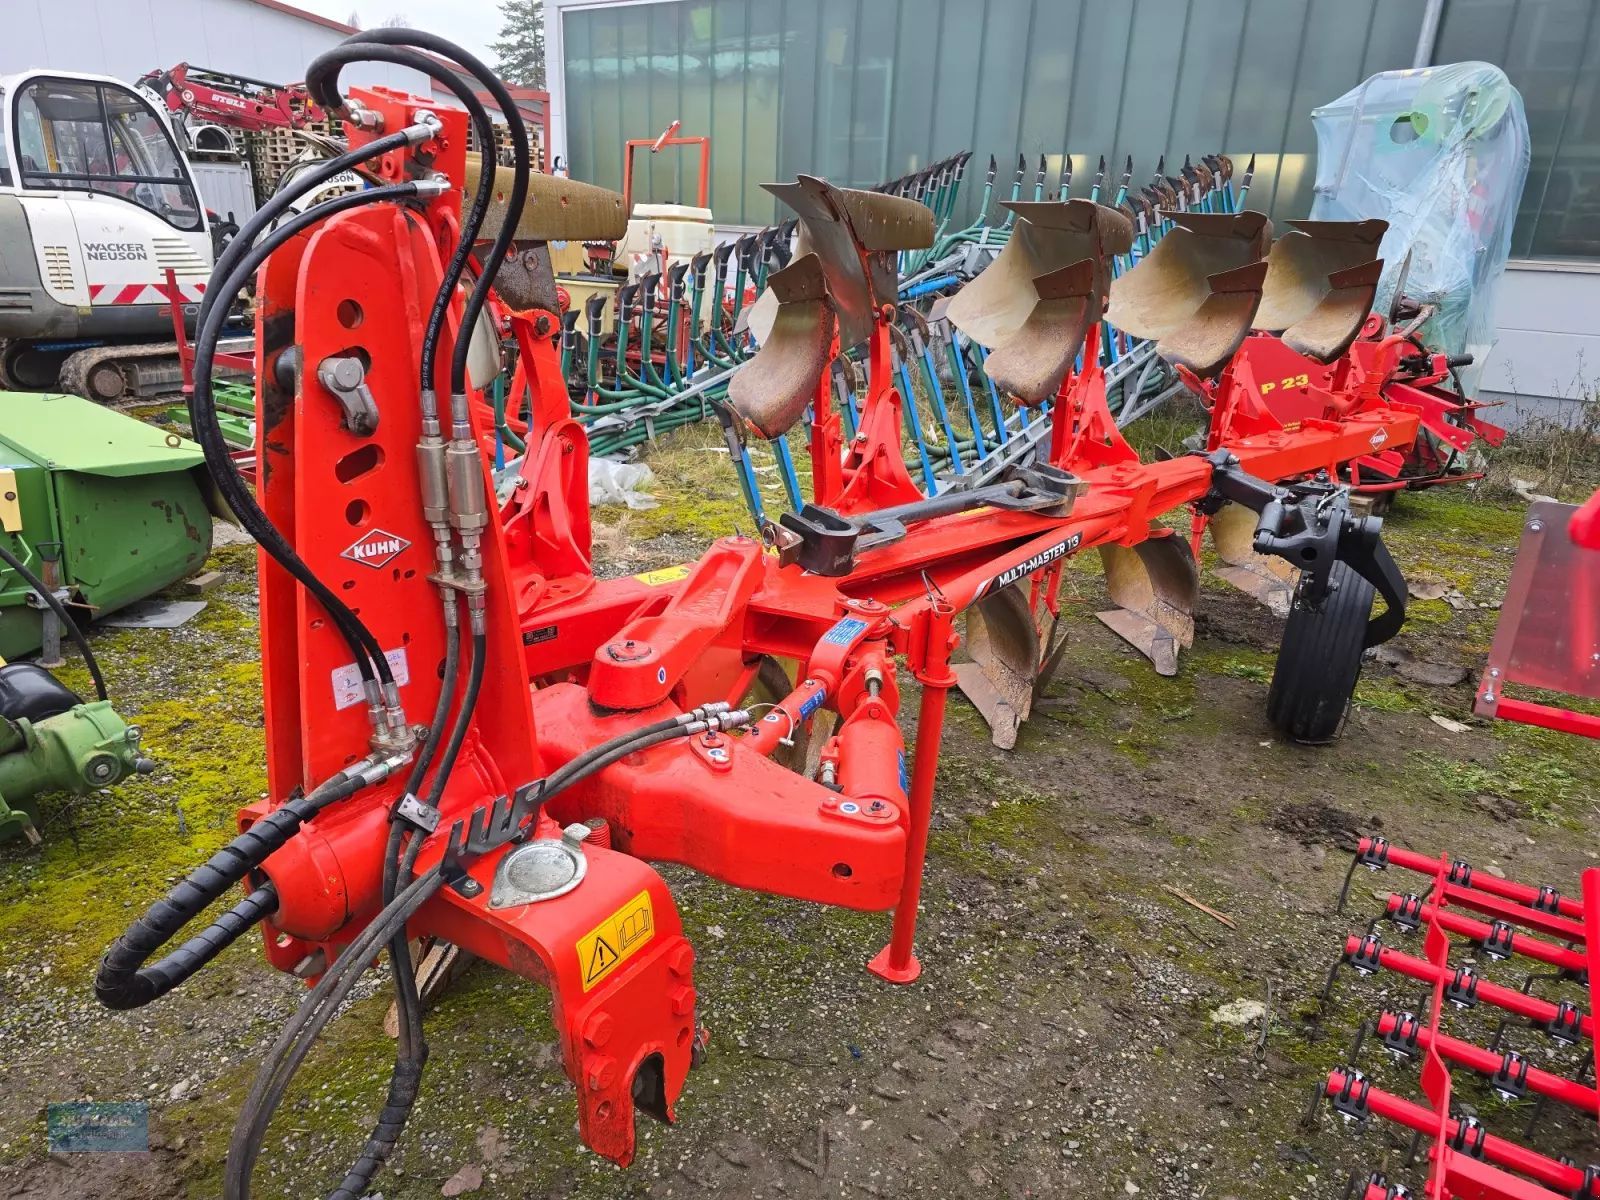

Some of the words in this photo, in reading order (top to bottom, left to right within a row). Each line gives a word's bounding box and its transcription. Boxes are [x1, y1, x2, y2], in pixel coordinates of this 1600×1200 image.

[84, 243, 146, 252] WACKER
[87, 252, 148, 261] NEUSON
[1261, 382, 1276, 395] P
[1281, 374, 1309, 390] 23
[353, 539, 400, 559] KUHN
[999, 541, 1066, 588] MULTI-MASTER
